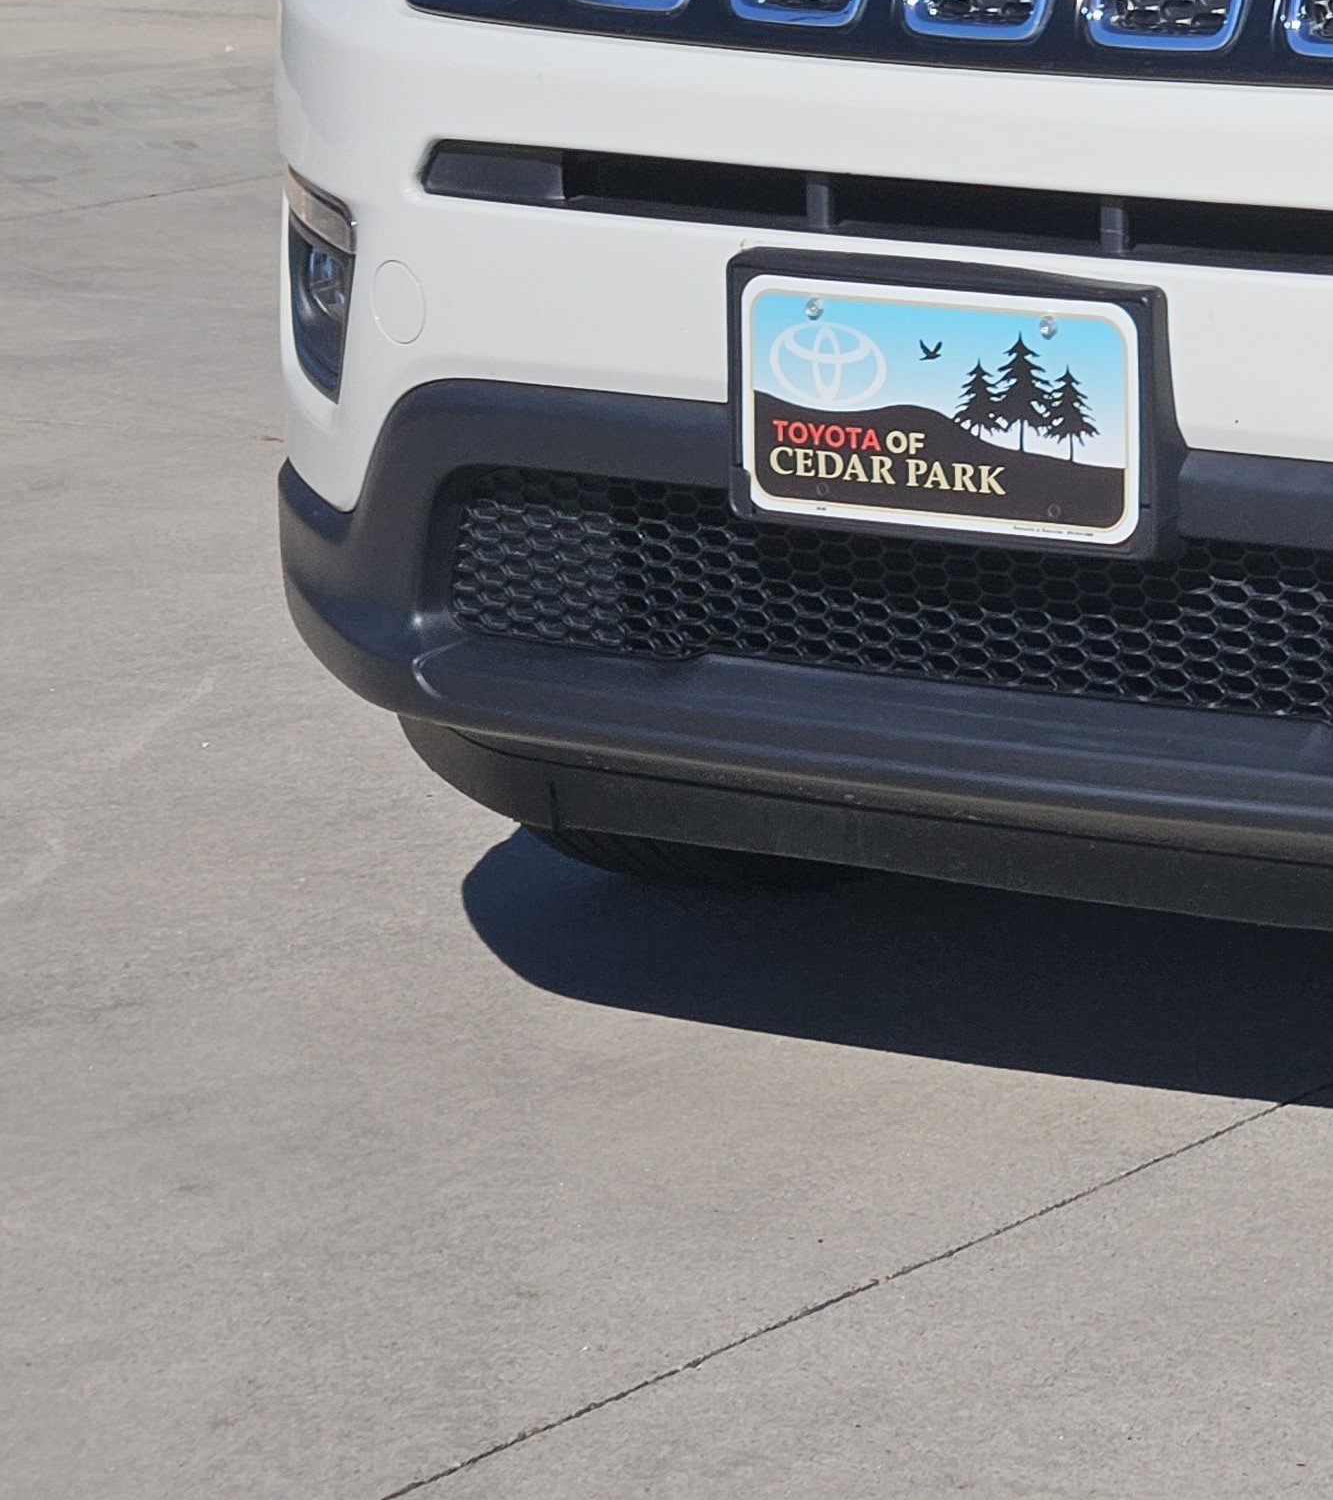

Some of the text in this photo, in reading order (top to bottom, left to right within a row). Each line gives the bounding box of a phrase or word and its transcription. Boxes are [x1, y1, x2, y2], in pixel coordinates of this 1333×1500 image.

[773, 419, 926, 455] TOYOTA OF
[769, 446, 1007, 496] CEDAR PARK
